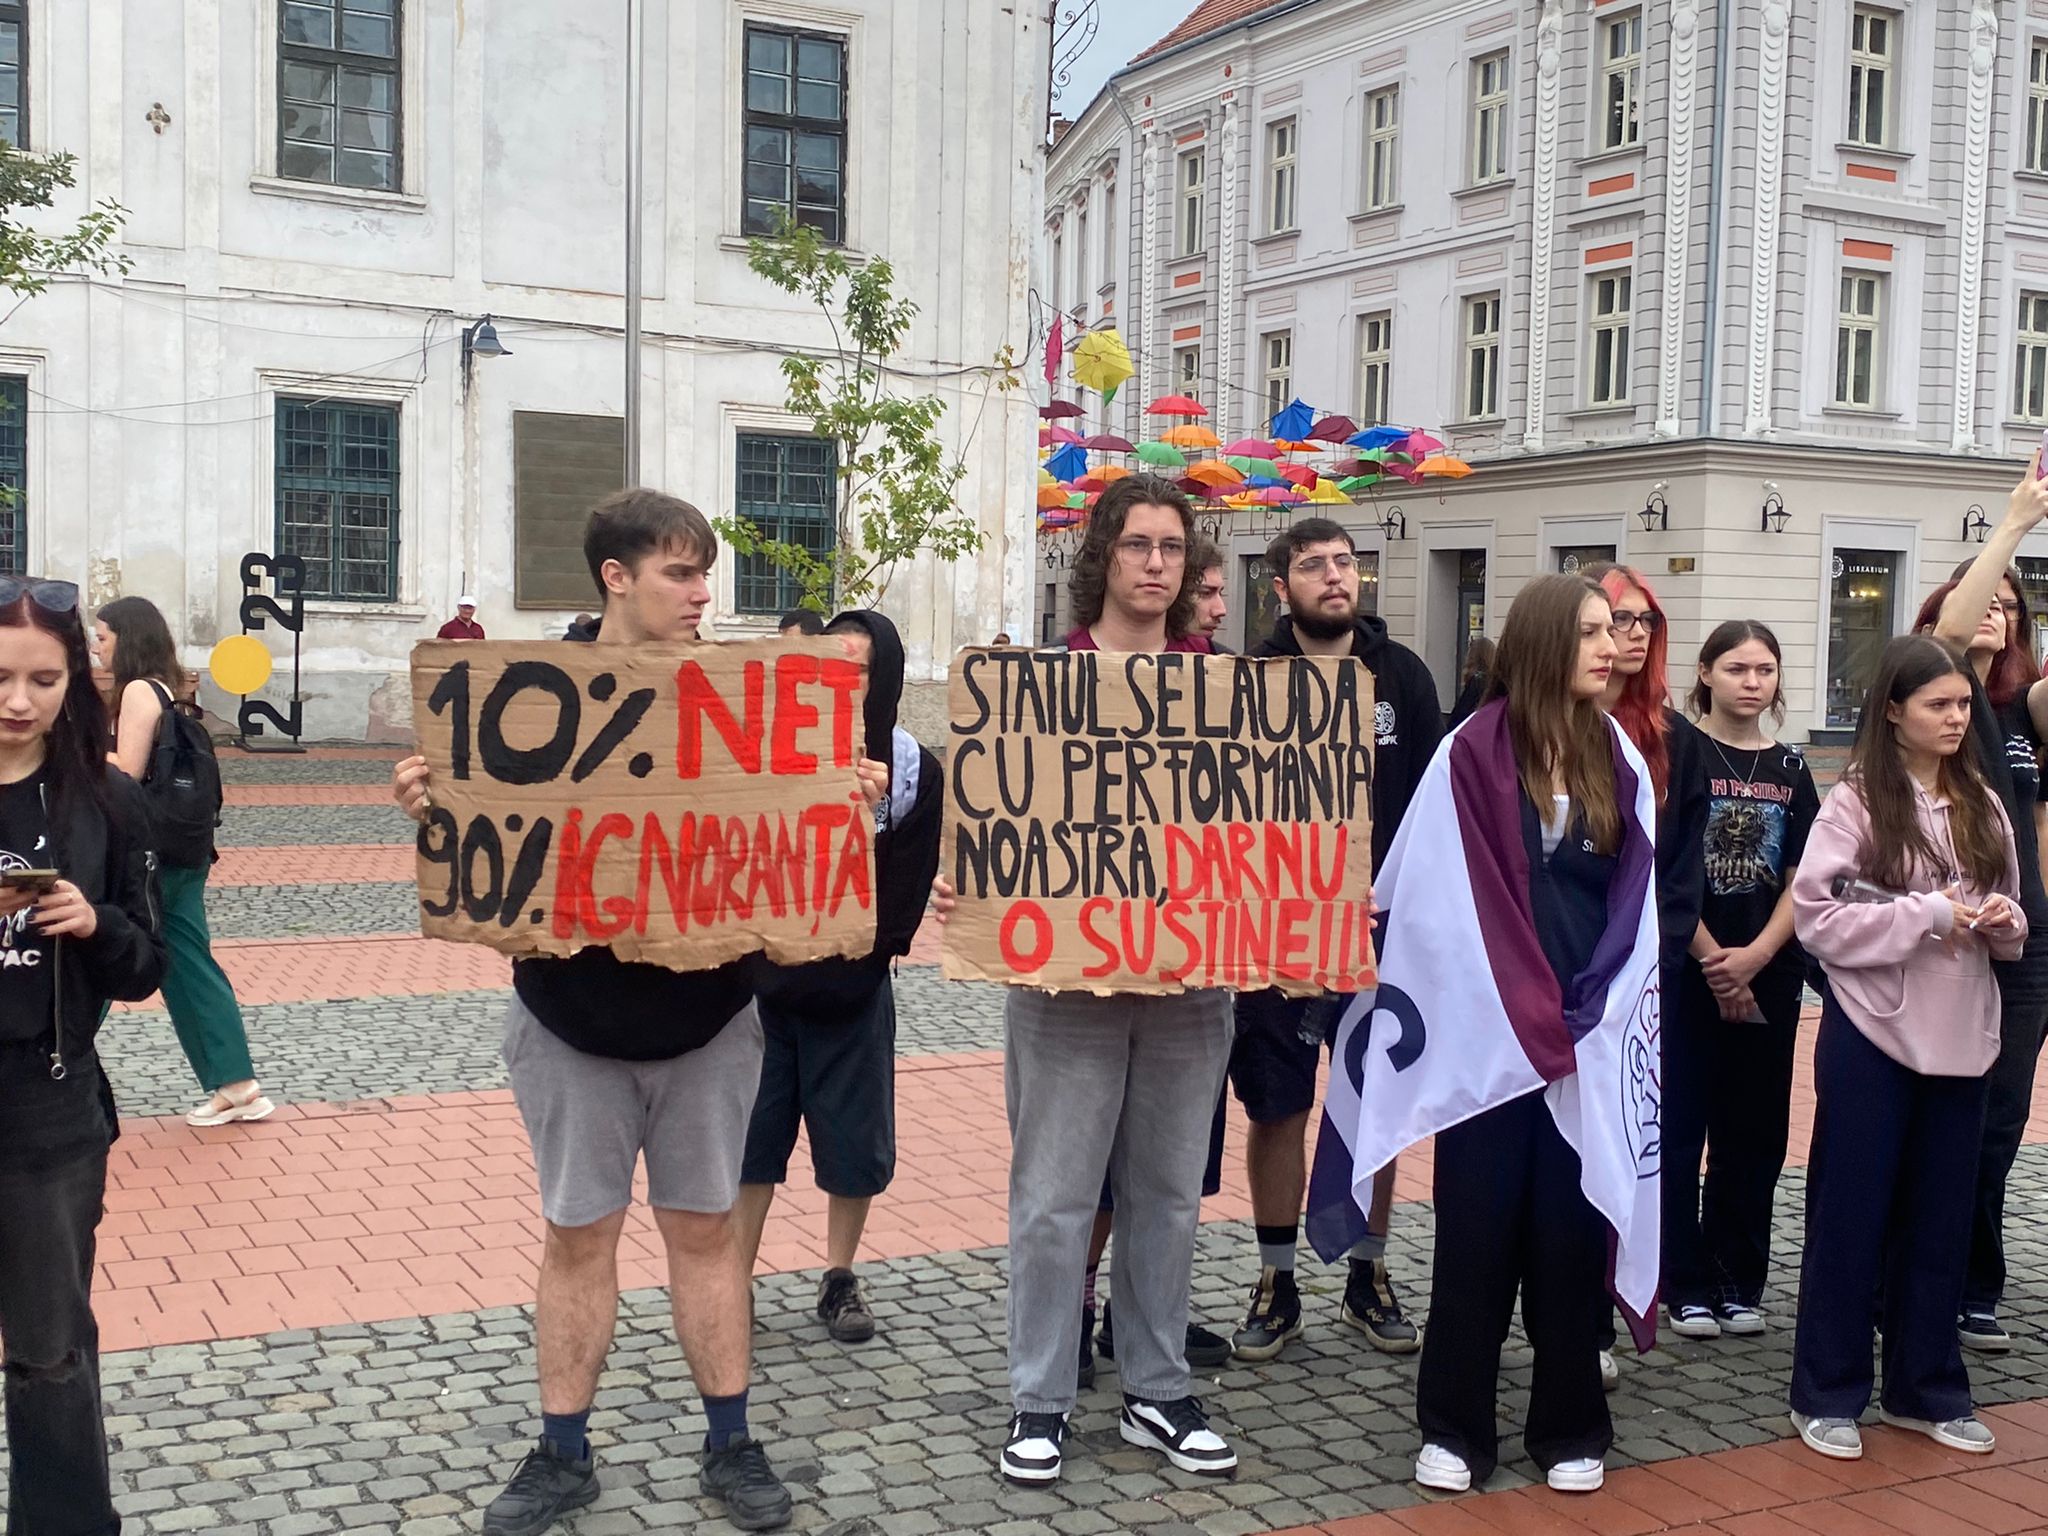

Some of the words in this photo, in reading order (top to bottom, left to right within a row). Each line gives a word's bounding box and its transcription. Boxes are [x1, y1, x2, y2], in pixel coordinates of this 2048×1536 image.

[427, 660, 656, 785] 10%
[676, 654, 862, 780] NET
[950, 651, 1117, 736] STATUL
[1120, 653, 1186, 740] SE
[952, 736, 1034, 818] CU
[417, 807, 554, 928] 90%
[999, 899, 1054, 974] O
